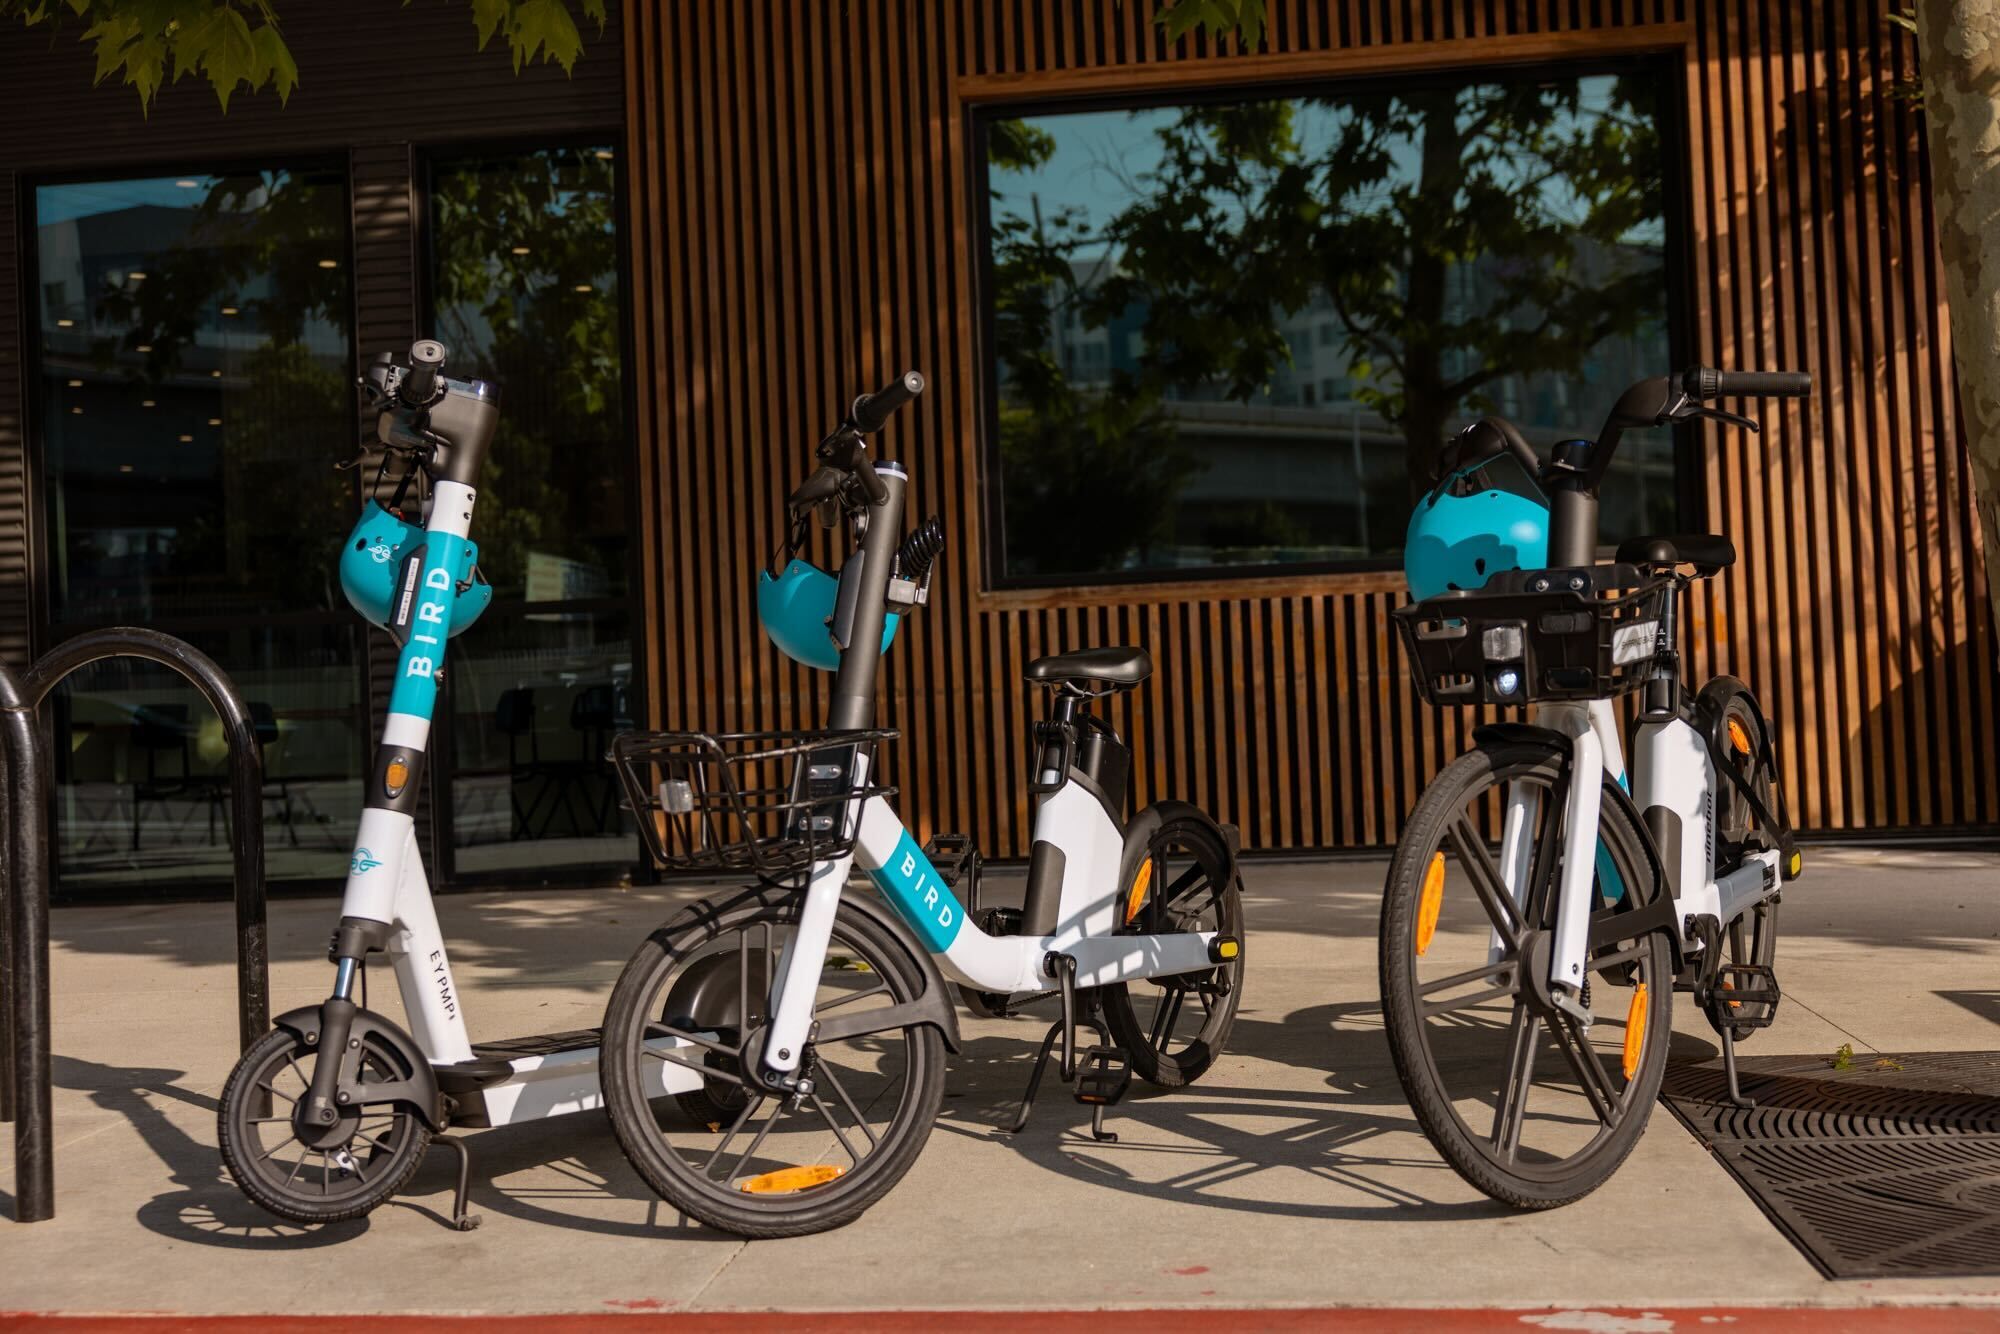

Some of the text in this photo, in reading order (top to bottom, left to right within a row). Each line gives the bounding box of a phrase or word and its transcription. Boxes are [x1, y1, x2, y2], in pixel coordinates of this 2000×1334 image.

[406, 567, 450, 678] BIRD
[1705, 791, 1713, 863] ninebot
[901, 851, 953, 927] BIRD
